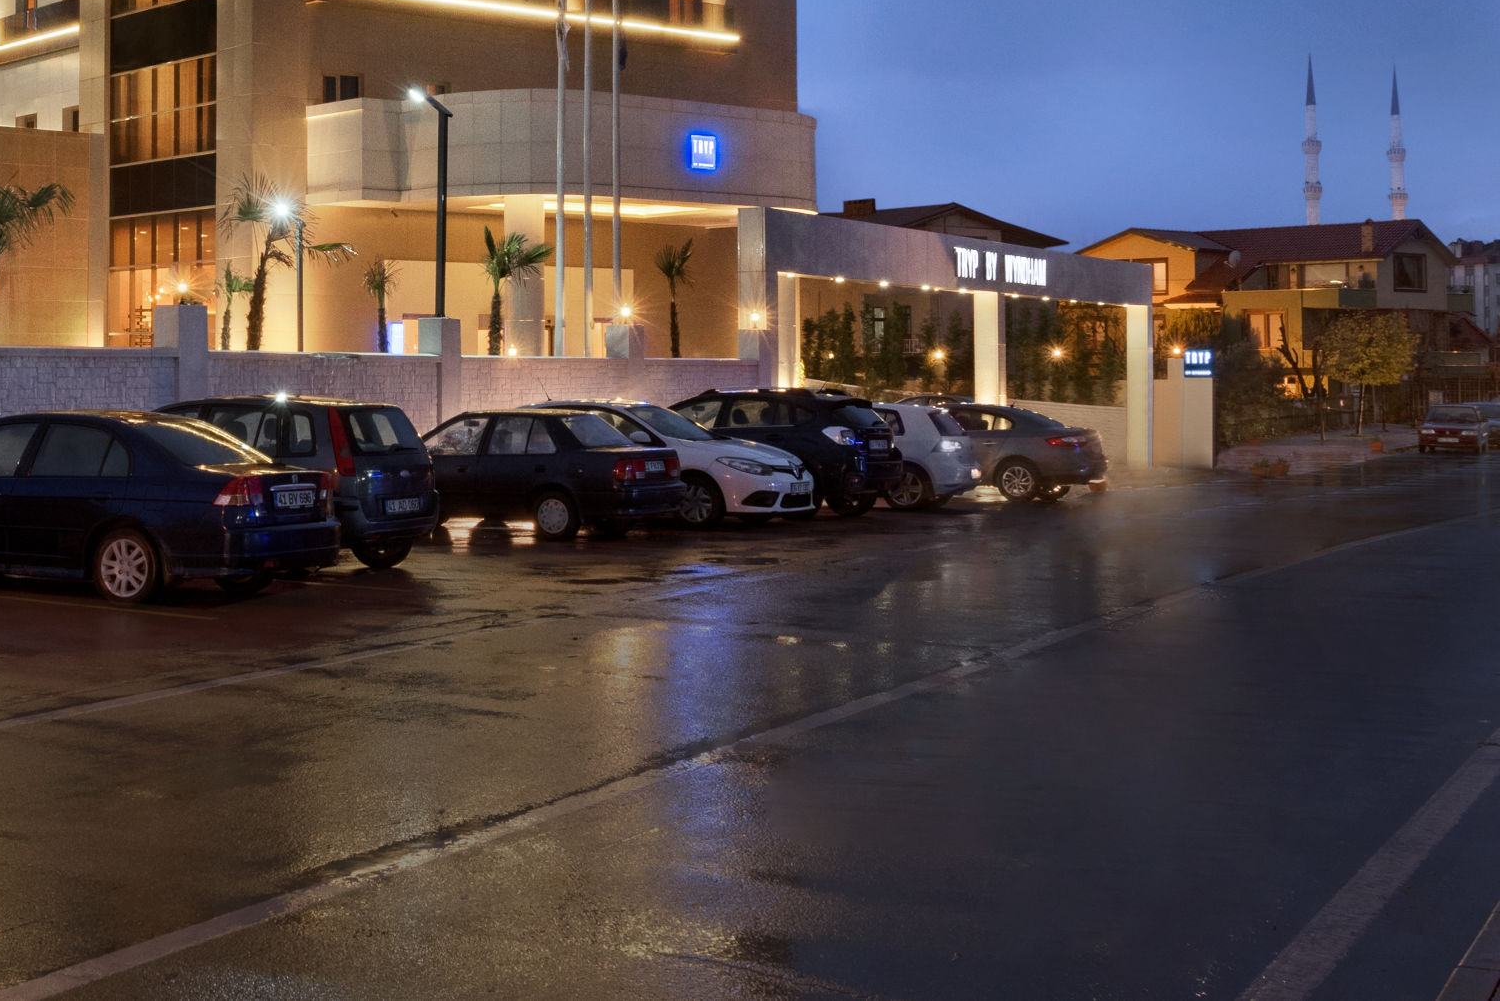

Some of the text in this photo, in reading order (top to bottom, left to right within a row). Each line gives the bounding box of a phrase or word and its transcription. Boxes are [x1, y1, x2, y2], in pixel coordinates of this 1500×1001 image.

[693, 139, 714, 155] TRYP
[954, 246, 1047, 287] TRYP BY WYNDHAM
[1184, 351, 1212, 364] TRYP
[278, 493, 287, 505] 41
